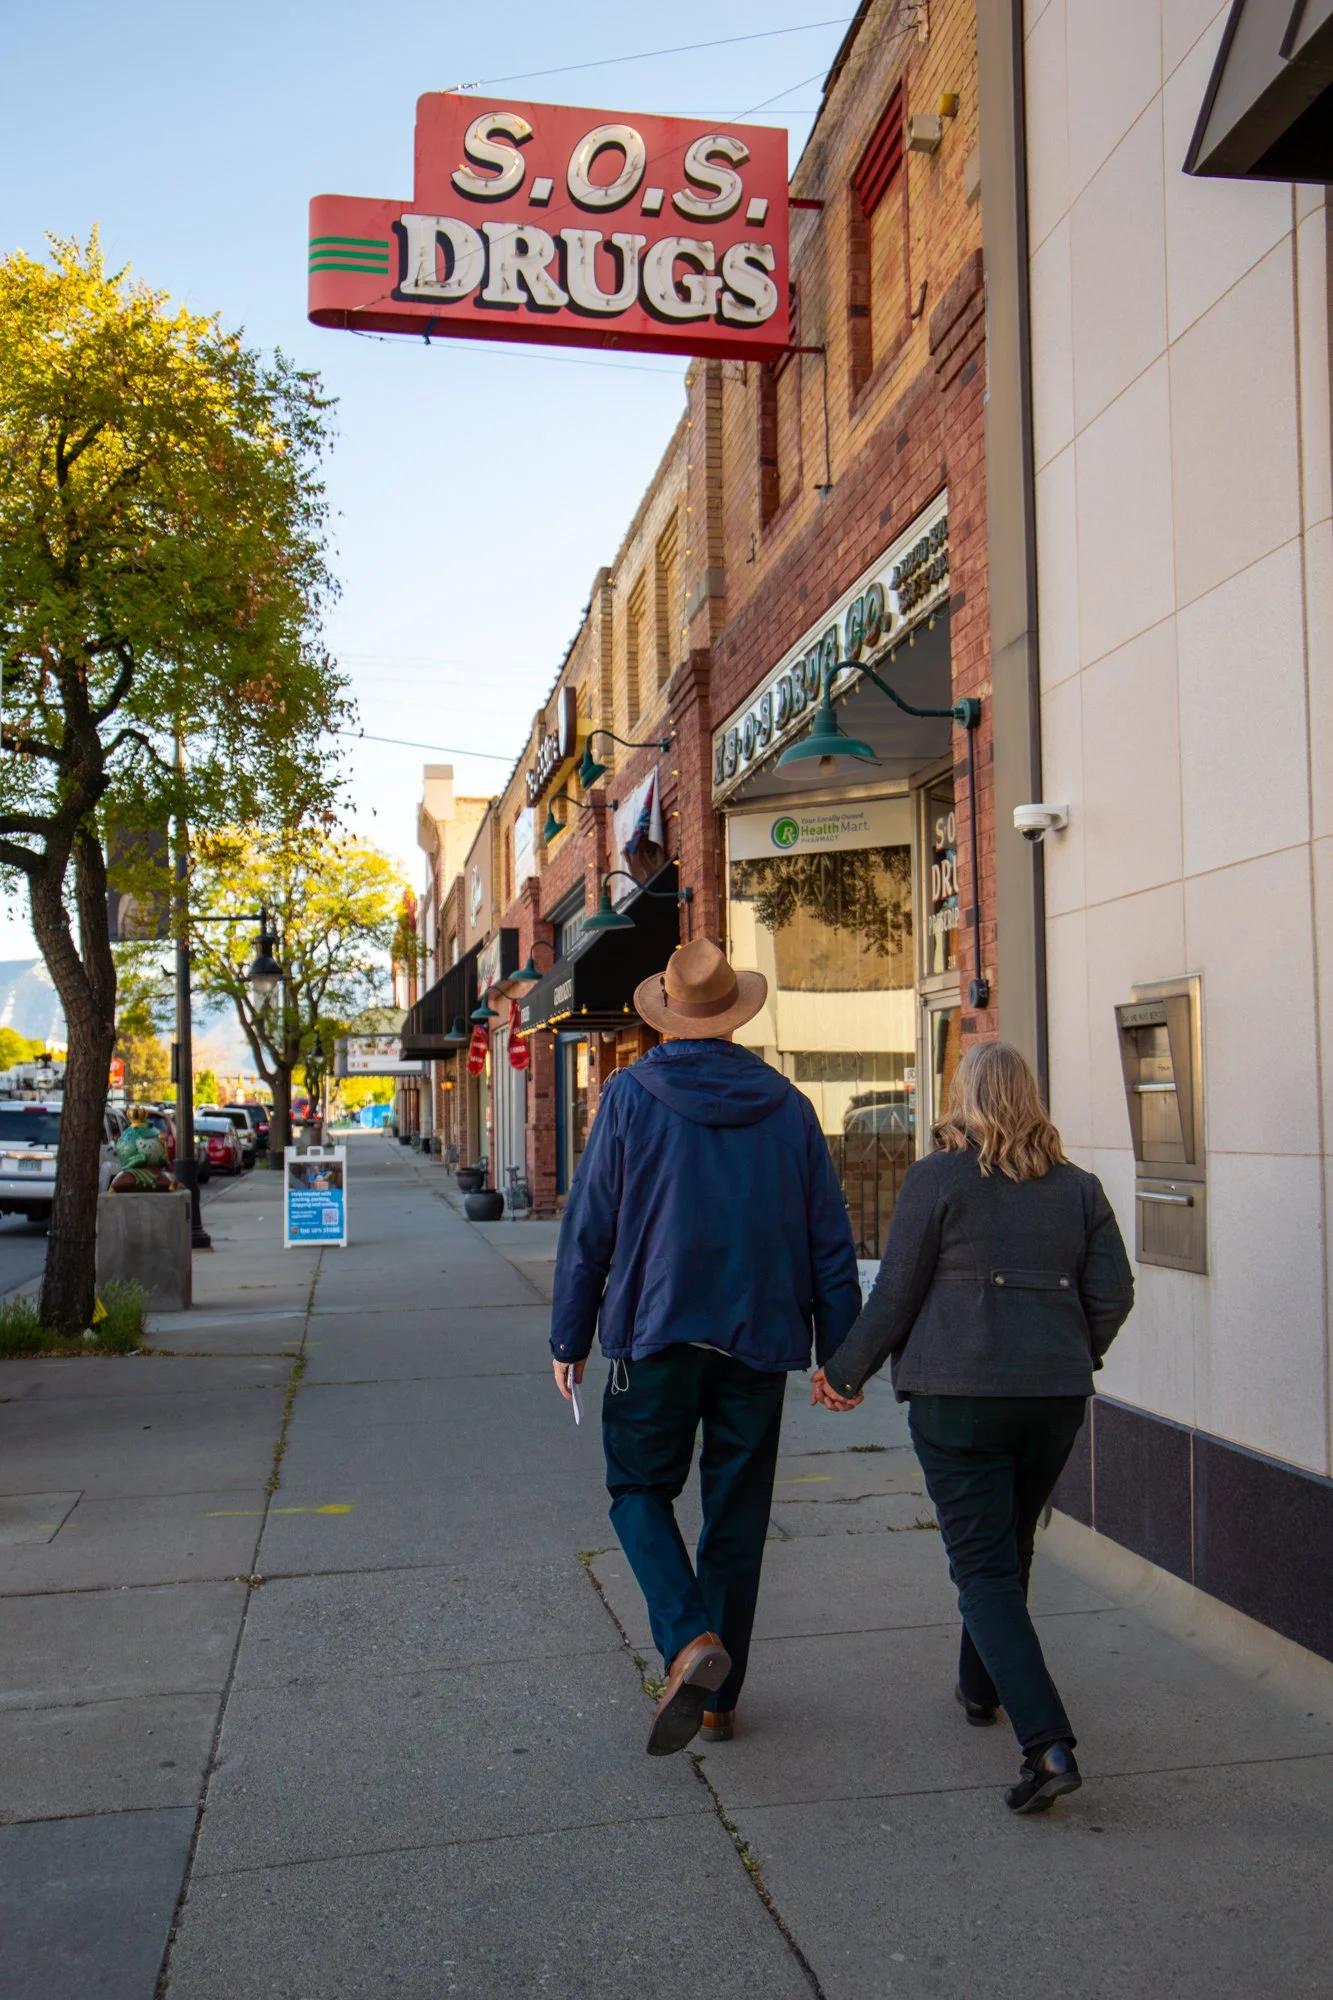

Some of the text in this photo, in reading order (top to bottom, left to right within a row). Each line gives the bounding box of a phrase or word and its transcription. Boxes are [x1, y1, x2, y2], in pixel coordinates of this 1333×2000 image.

[450, 111, 769, 221] S.O.S.
[398, 213, 779, 322] DRUGS
[776, 623, 839, 731] DRUG
[801, 822, 839, 836] Health
[801, 835, 838, 844] PHARMACY
